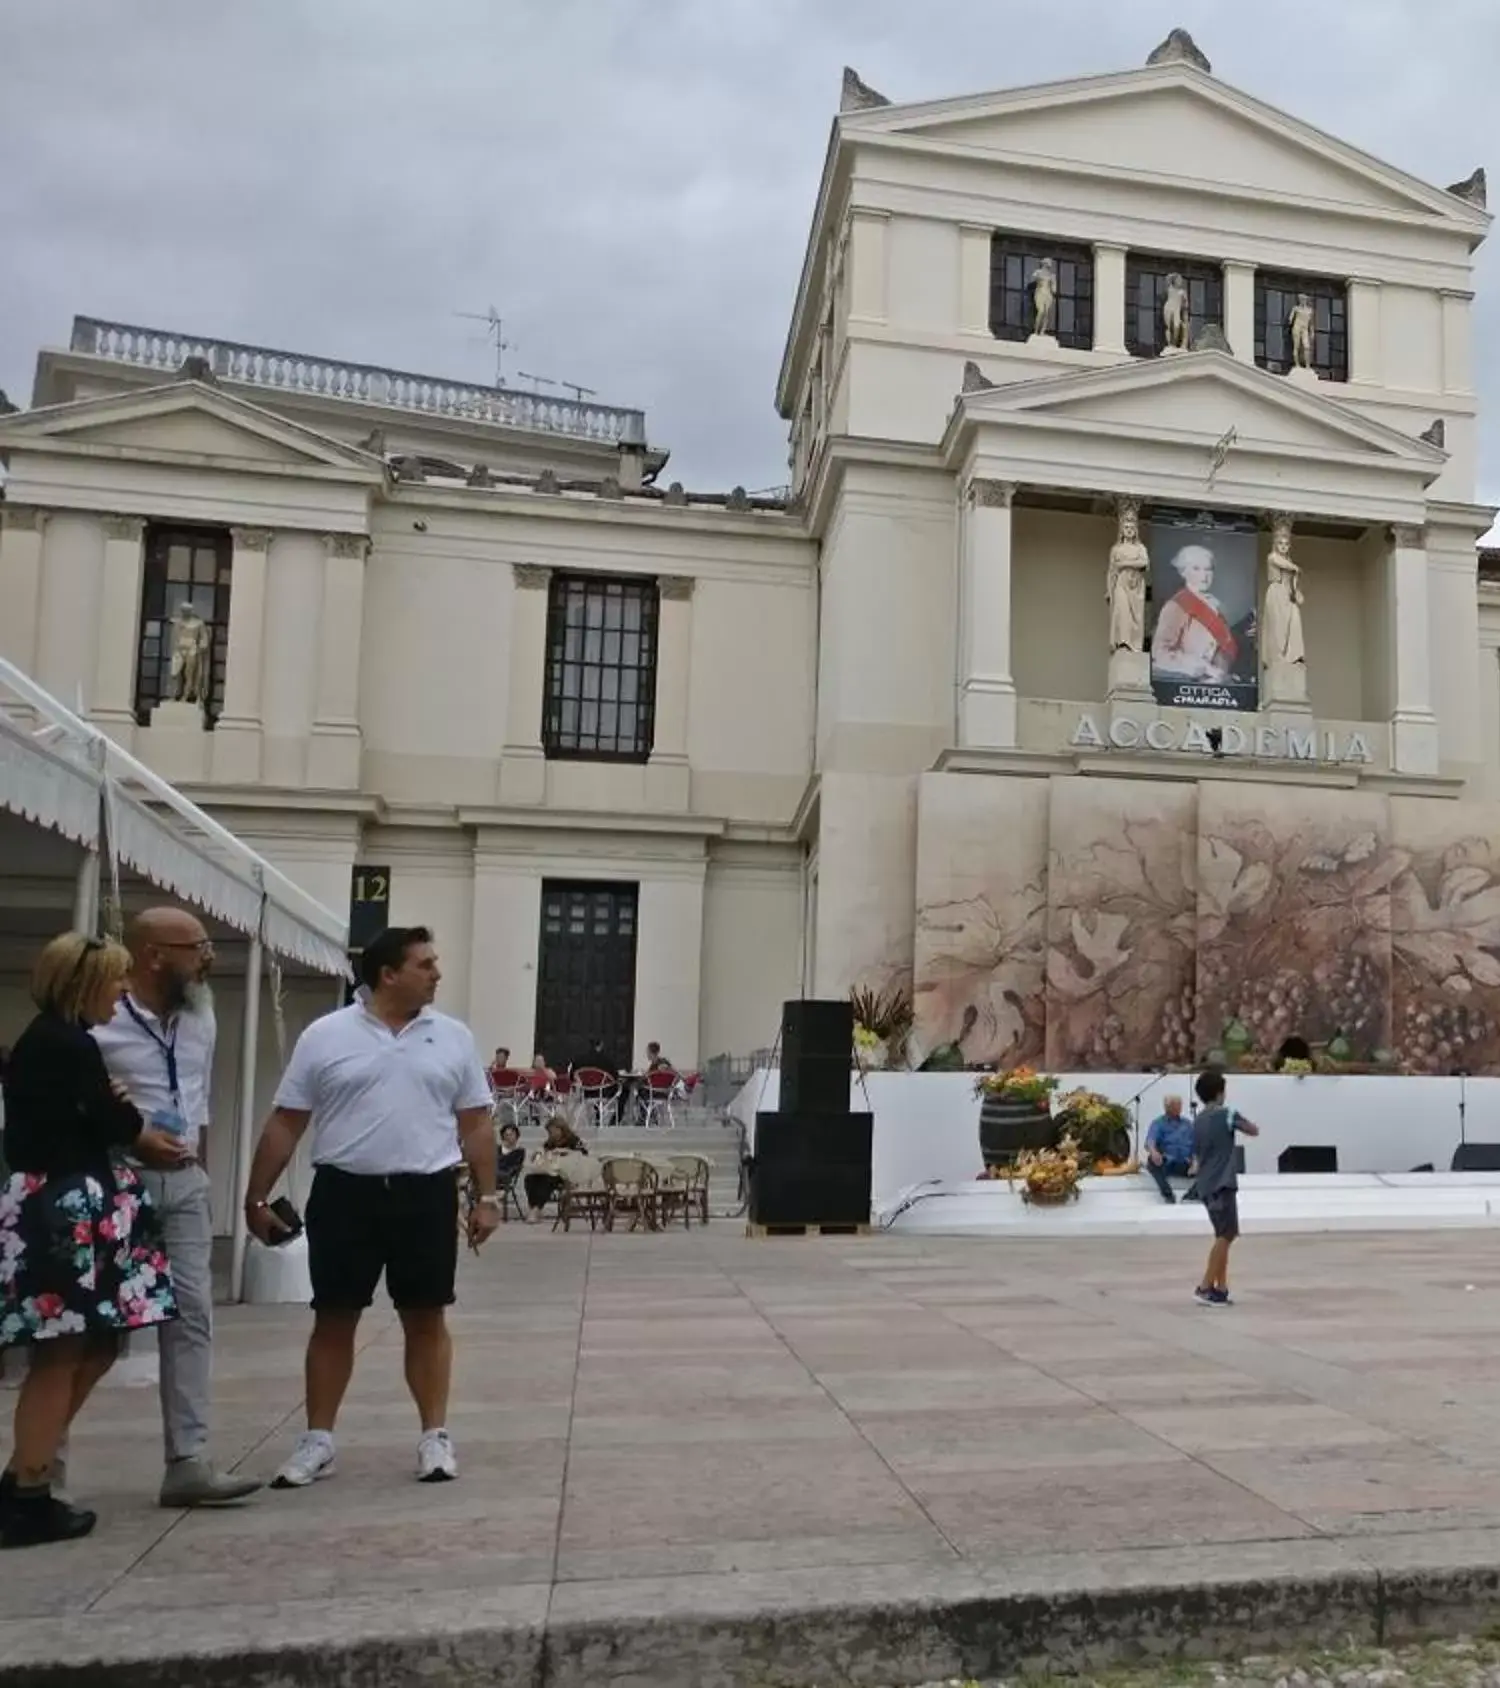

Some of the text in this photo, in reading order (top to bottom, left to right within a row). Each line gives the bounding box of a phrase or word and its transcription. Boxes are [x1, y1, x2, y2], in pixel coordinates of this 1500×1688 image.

[1179, 685, 1232, 699] OTTICA
[1072, 714, 1374, 763] ACCADEMIA
[355, 875, 387, 901] 12
